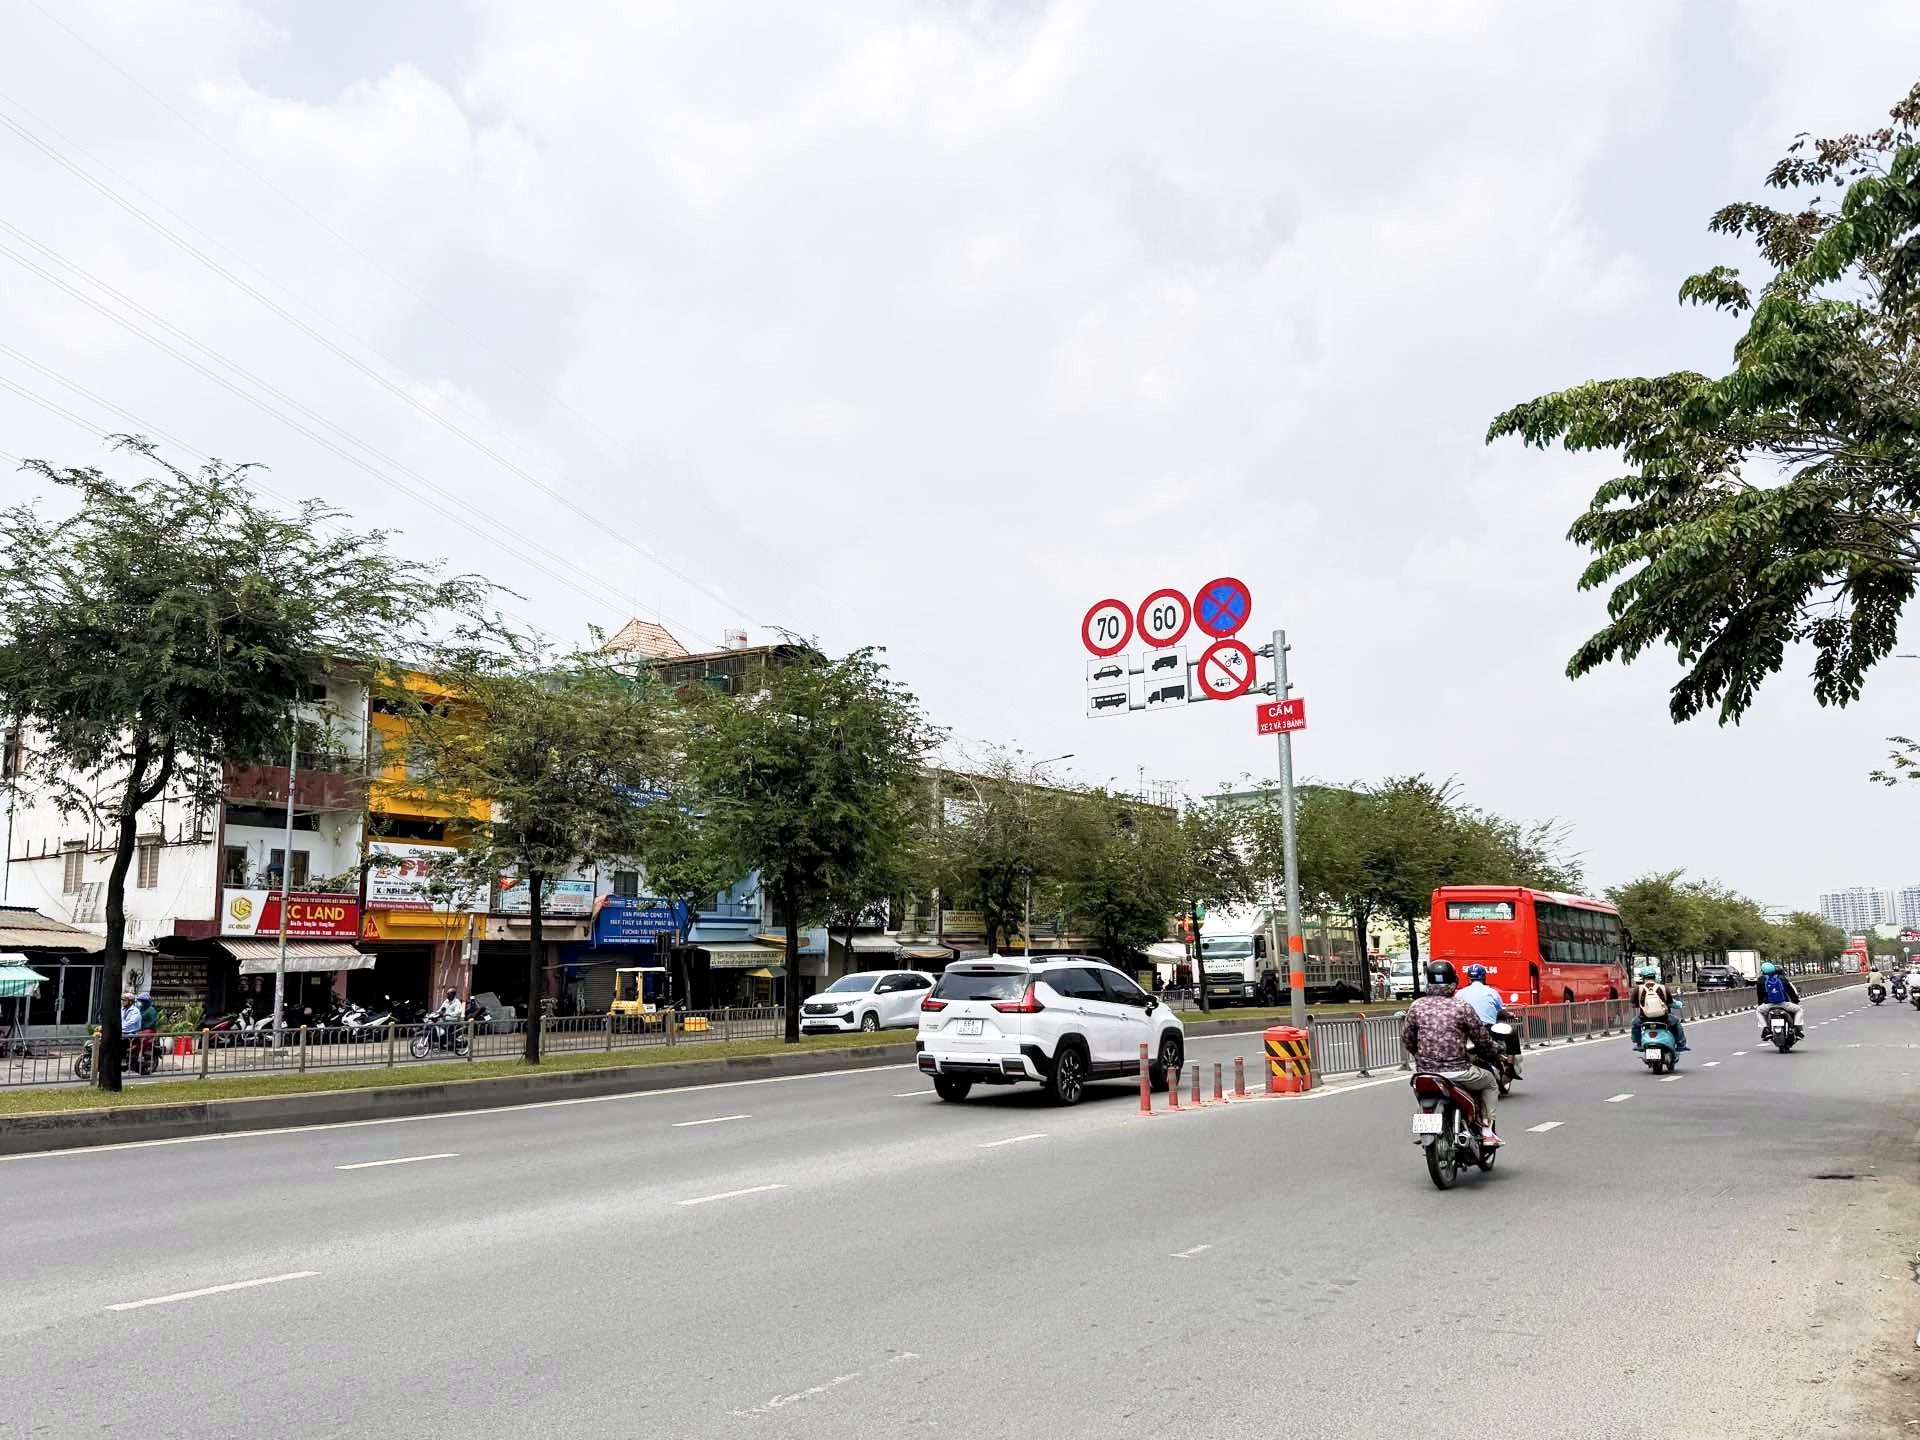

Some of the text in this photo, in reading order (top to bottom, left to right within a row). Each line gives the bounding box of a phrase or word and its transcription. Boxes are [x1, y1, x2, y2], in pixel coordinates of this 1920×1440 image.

[1153, 605, 1176, 631] 60
[1097, 615, 1120, 641] 70
[1268, 702, 1293, 717] CẤM
[1260, 723, 1269, 732] XE
[1274, 719, 1282, 729] VÀ
[1287, 717, 1304, 729] BÁNH
[306, 906, 345, 921] LAND
